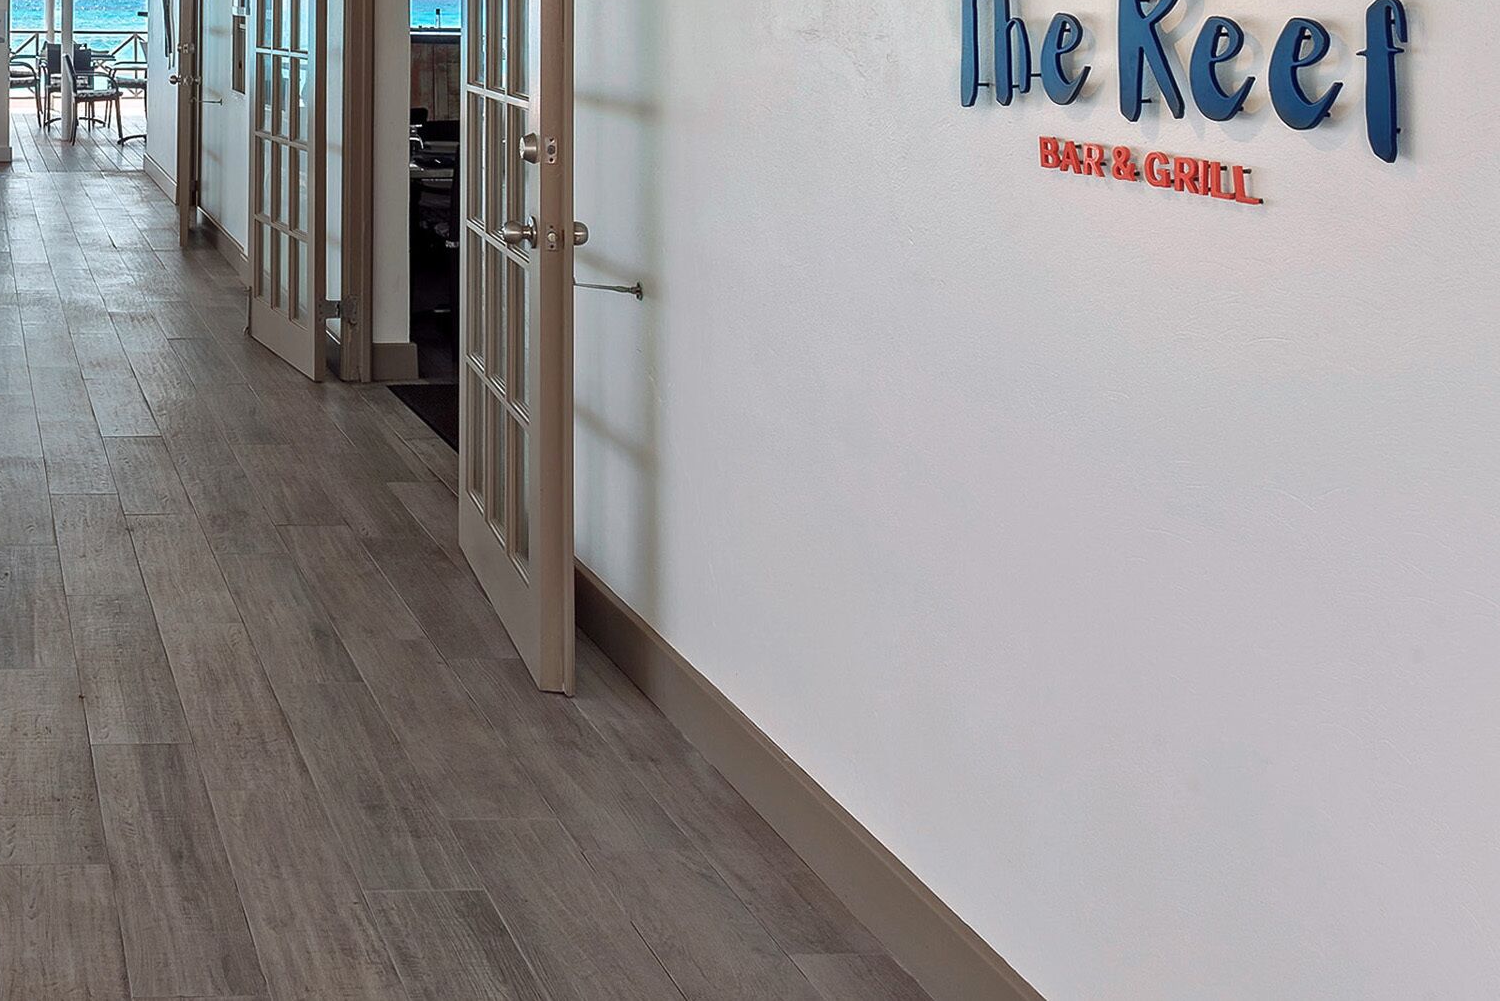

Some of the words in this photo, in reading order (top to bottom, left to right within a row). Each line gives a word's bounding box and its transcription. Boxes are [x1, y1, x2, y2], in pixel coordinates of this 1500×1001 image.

[1038, 135, 1106, 178] BAR
[1111, 145, 1138, 182] &
[1143, 150, 1262, 205] GRILL
